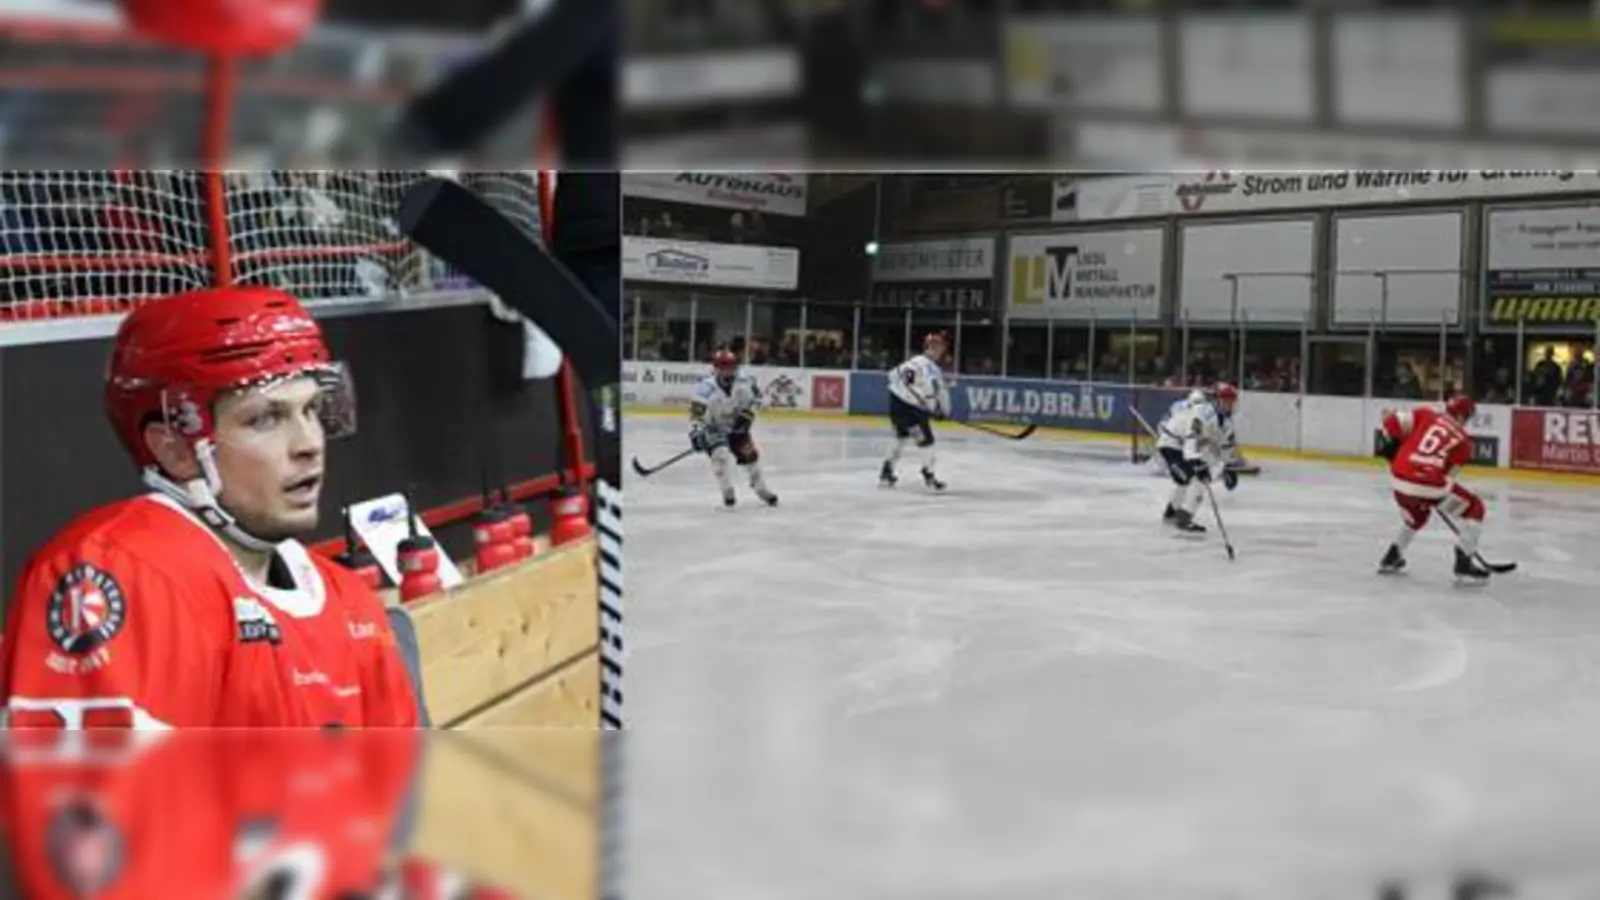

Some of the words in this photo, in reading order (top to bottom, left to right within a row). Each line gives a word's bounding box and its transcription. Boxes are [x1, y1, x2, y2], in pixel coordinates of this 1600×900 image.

[674, 172, 804, 199] AUTOHAUS
[1242, 173, 1302, 197] Strom
[1307, 171, 1349, 191] und
[965, 385, 1115, 421] WILDBRÄU
